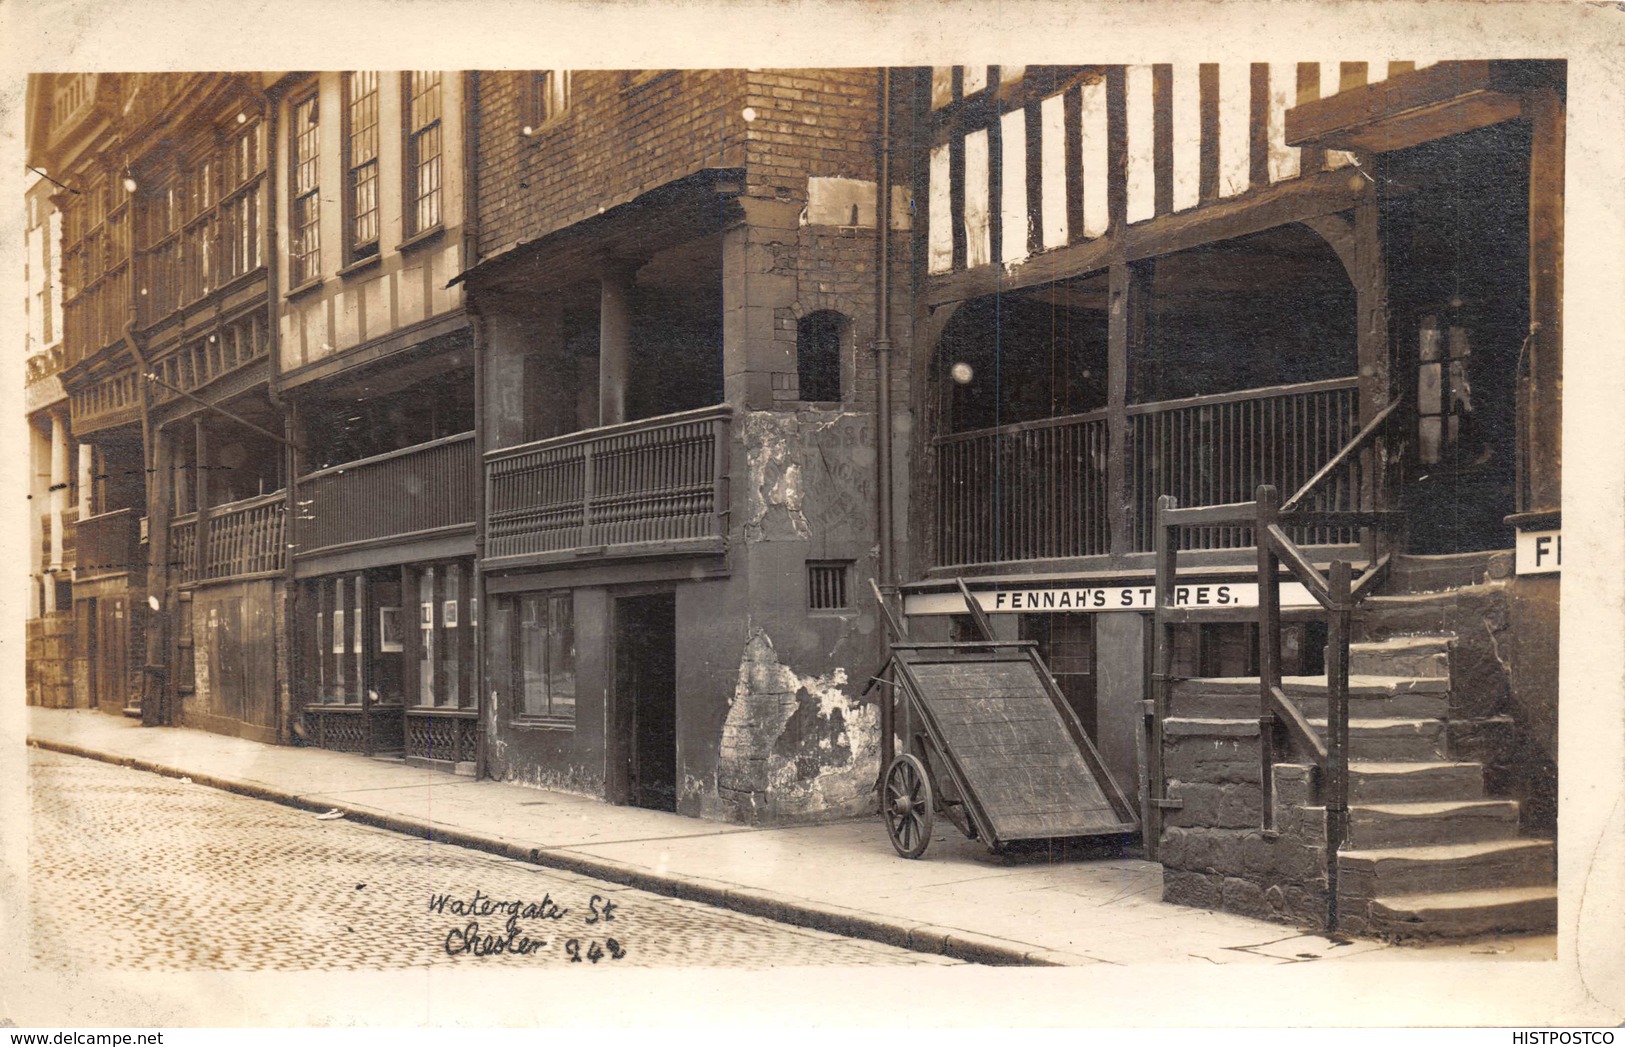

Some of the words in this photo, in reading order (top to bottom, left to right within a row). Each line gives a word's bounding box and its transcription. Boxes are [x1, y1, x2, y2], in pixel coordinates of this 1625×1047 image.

[996, 588, 1106, 609] FENNAH'S
[1120, 586, 1239, 606] STRES.
[585, 894, 618, 924] St
[445, 921, 547, 957] Chester
